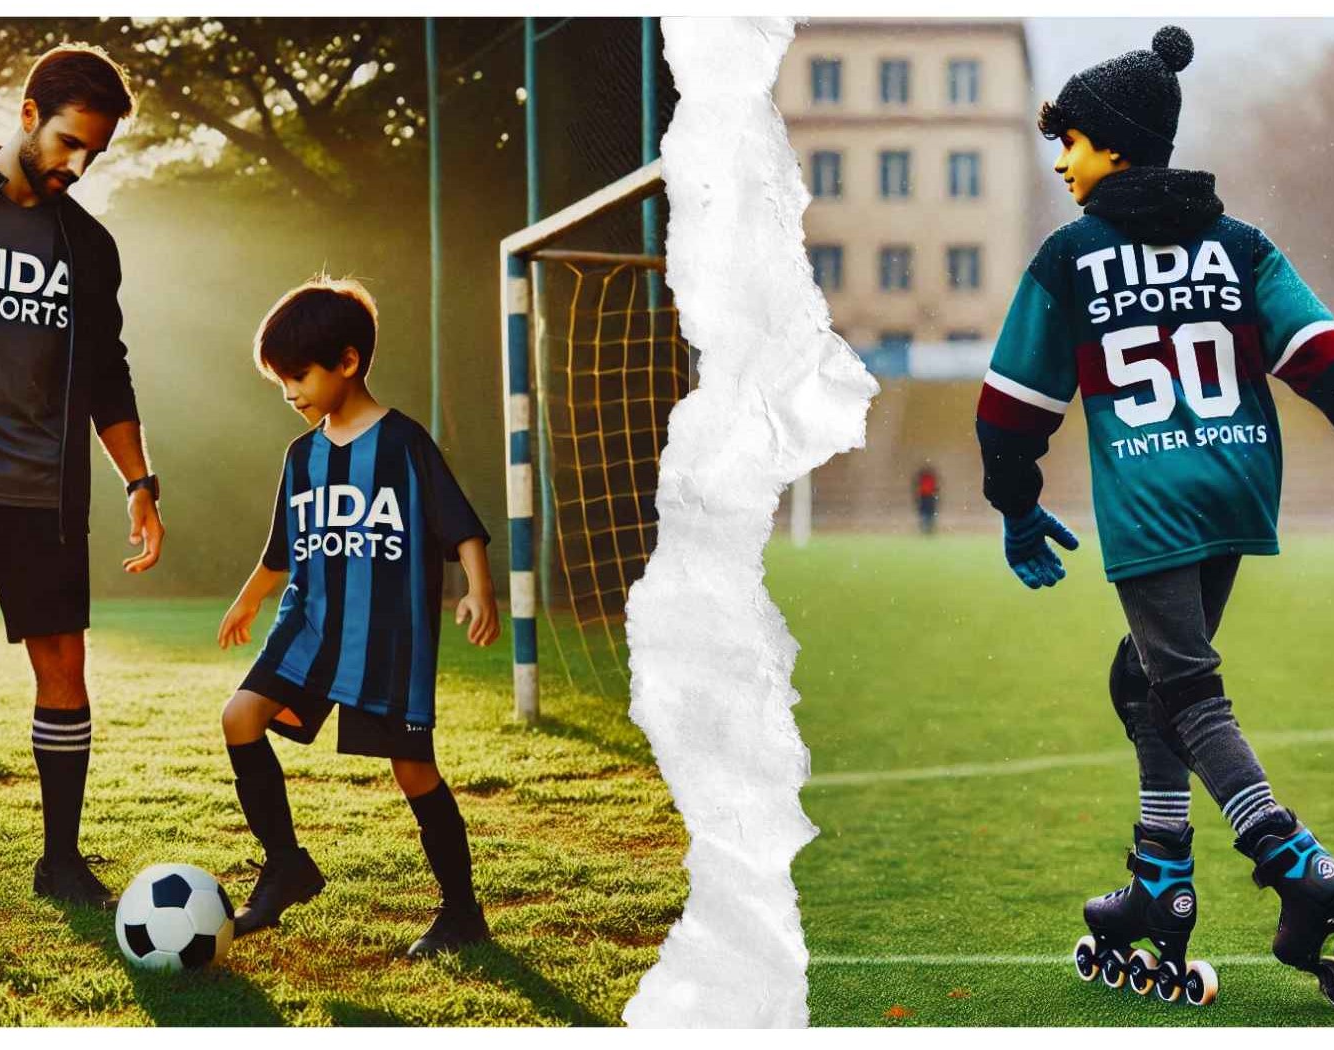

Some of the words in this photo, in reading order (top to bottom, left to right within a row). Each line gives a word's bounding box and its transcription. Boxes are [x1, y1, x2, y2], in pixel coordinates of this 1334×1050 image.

[1076, 240, 1240, 294] TIDA
[1088, 285, 1242, 324] SPORTS
[1101, 321, 1241, 428] 50
[1195, 424, 1268, 447] SPORTS
[290, 484, 404, 533] TIDA
[293, 531, 403, 562] SPORTS
